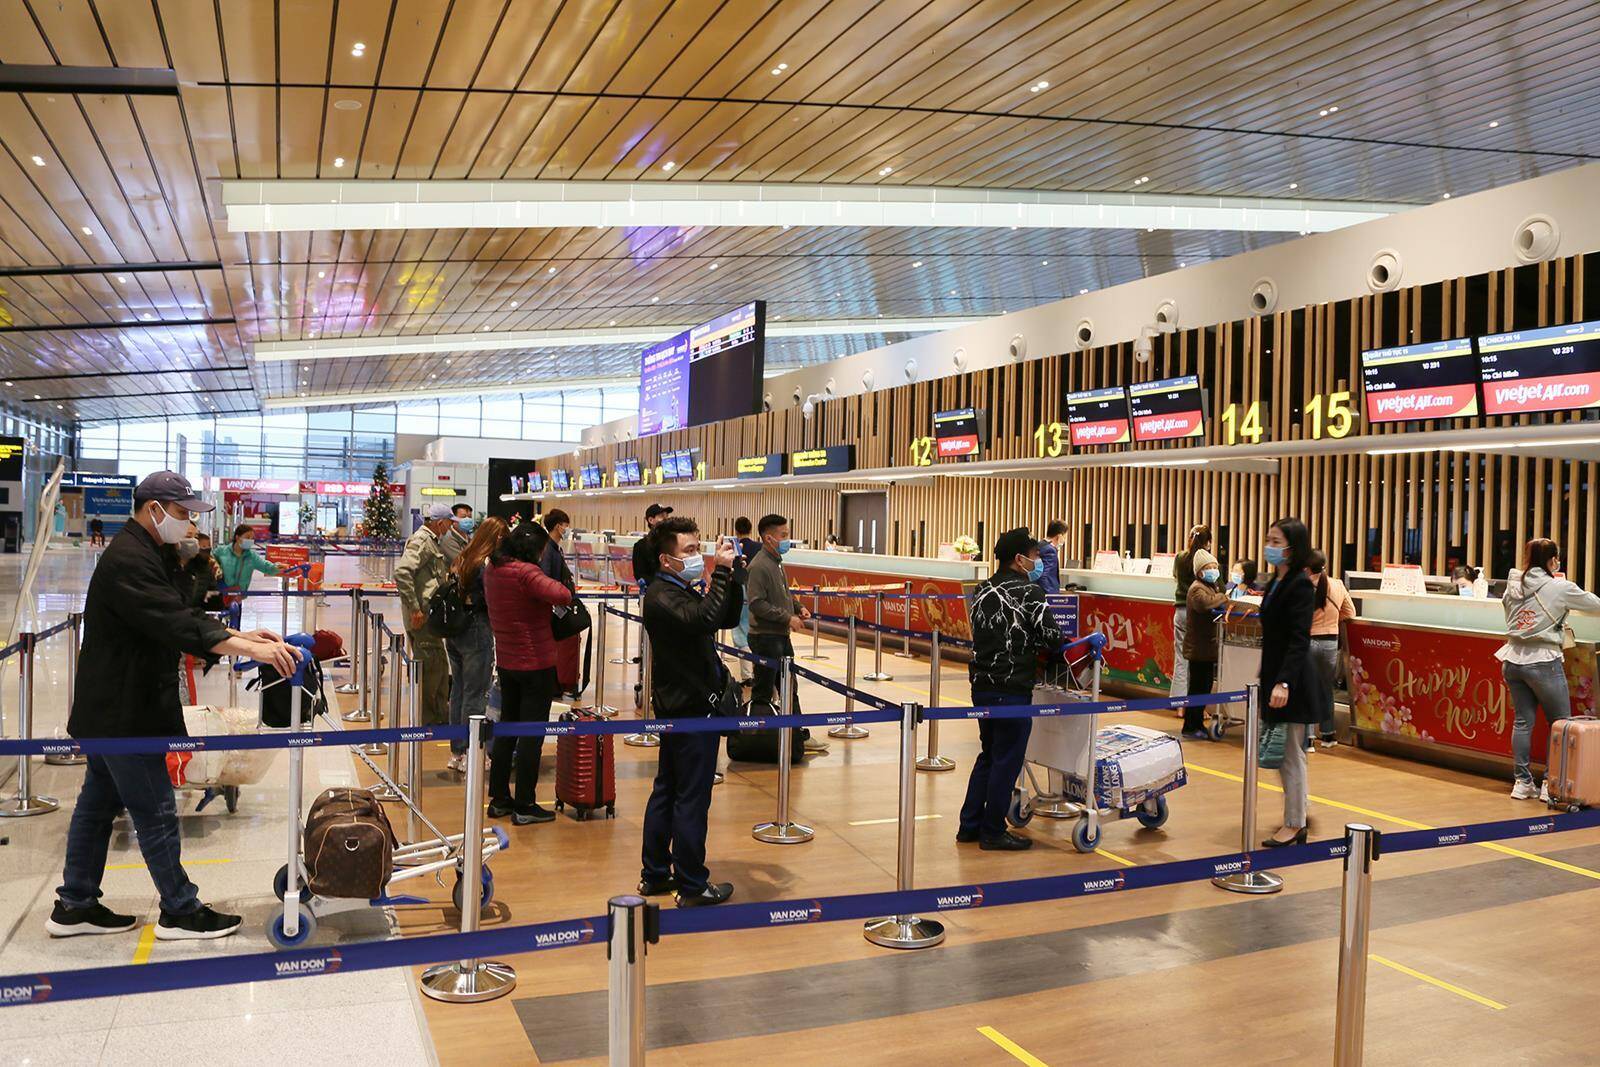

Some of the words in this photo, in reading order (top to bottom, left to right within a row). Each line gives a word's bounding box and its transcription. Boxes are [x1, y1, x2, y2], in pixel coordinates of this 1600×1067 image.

[1221, 400, 1264, 445] 14
[1304, 391, 1352, 440] 15
[1034, 422, 1062, 458] 13
[910, 436, 931, 467] 12
[696, 461, 706, 481] 11
[1086, 609, 1136, 652] 2021
[1363, 637, 1377, 646] VAN
[1376, 639, 1391, 648] DON
[1386, 658, 1470, 702] Happy
[1435, 697, 1488, 740] New
[1110, 765, 1120, 788] LONG
[1228, 862, 1242, 870] DON
[1083, 881, 1098, 889] VAN
[1099, 879, 1114, 887] DON
[936, 897, 953, 905] VAN
[954, 895, 971, 903] DON
[770, 911, 788, 920] VAN
[789, 909, 808, 918] DON
[535, 932, 557, 943] VAN
[557, 930, 579, 941] DON
[275, 960, 299, 972] VAN
[300, 958, 325, 969] DON
[3, 985, 32, 998] DON
